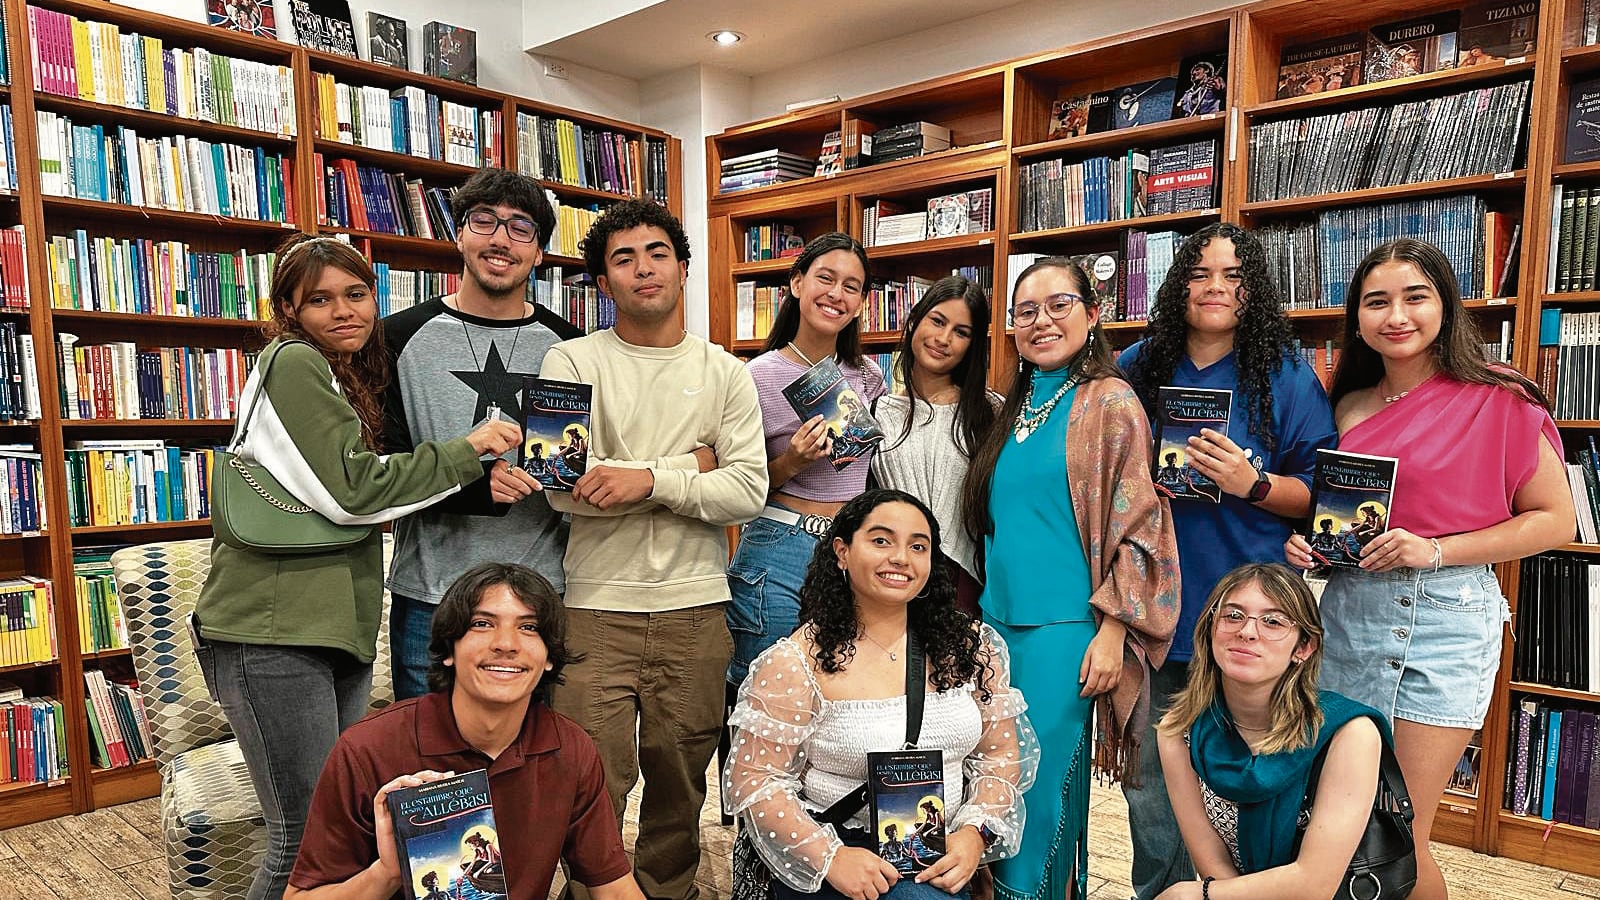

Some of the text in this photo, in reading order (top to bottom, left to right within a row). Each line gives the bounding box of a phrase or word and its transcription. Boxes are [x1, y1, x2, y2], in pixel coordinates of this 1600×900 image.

[1486, 2, 1536, 21] TIZIANO
[295, 9, 351, 41] POLICE
[1388, 23, 1435, 41] DURERO
[1287, 42, 1359, 62] TOULOUSE-LAUTREC
[1153, 171, 1208, 187] ARTE VISUAL
[1192, 199, 1211, 208] RAFAEL
